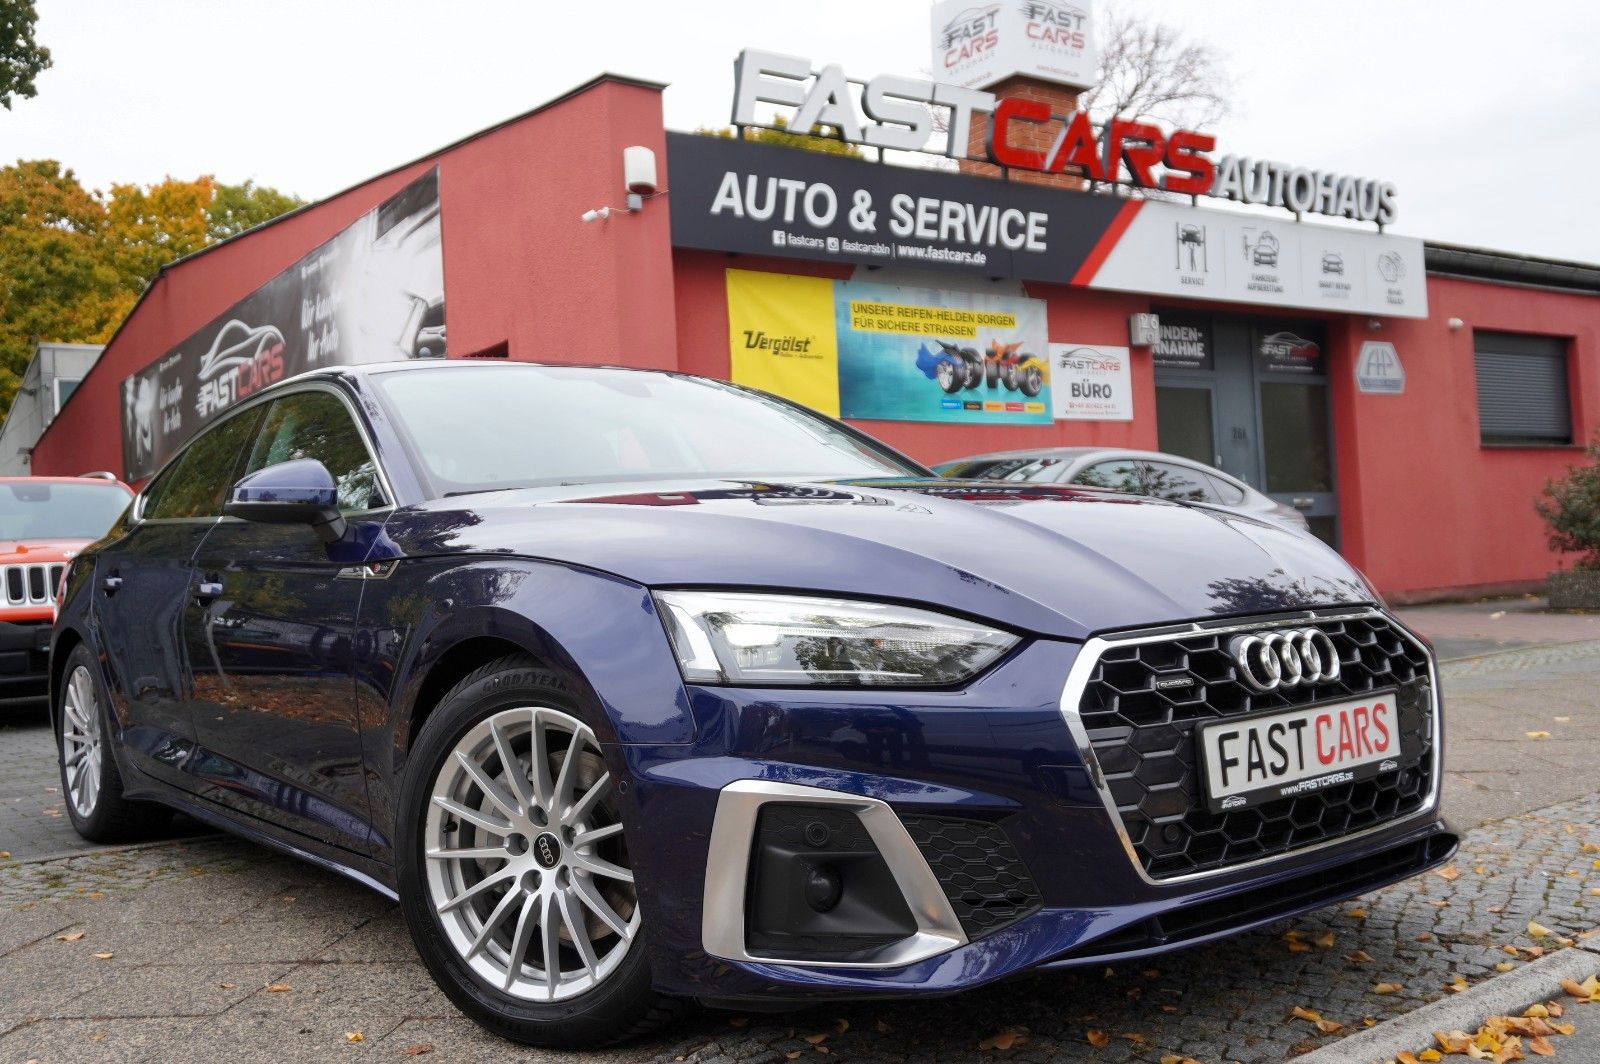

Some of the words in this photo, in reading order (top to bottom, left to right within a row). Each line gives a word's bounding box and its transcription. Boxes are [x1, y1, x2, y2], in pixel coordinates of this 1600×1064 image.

[947, 9, 999, 48] FAST
[1029, 4, 1086, 30] FAST
[944, 28, 999, 68] CARS
[1026, 22, 1085, 49] CARS
[1215, 154, 1399, 226] AUTOHAUS
[711, 171, 838, 228] AUTO
[849, 188, 877, 231] &
[890, 193, 1049, 251] SERVICE
[787, 233, 825, 248] fastcars
[898, 244, 987, 265] www.fastcars.de
[1181, 276, 1205, 286] SERVICE
[852, 303, 894, 316] UNSERE
[897, 306, 975, 323] REIFEN-HELDEN
[976, 314, 1015, 326] SORGEN
[877, 320, 921, 332] SICHERE
[923, 323, 976, 336] STRASSEN!
[743, 330, 811, 355] Vergölst
[1060, 360, 1121, 371] FASTCARS
[198, 343, 284, 417] FASTCARS
[1071, 378, 1112, 398] BÜRO
